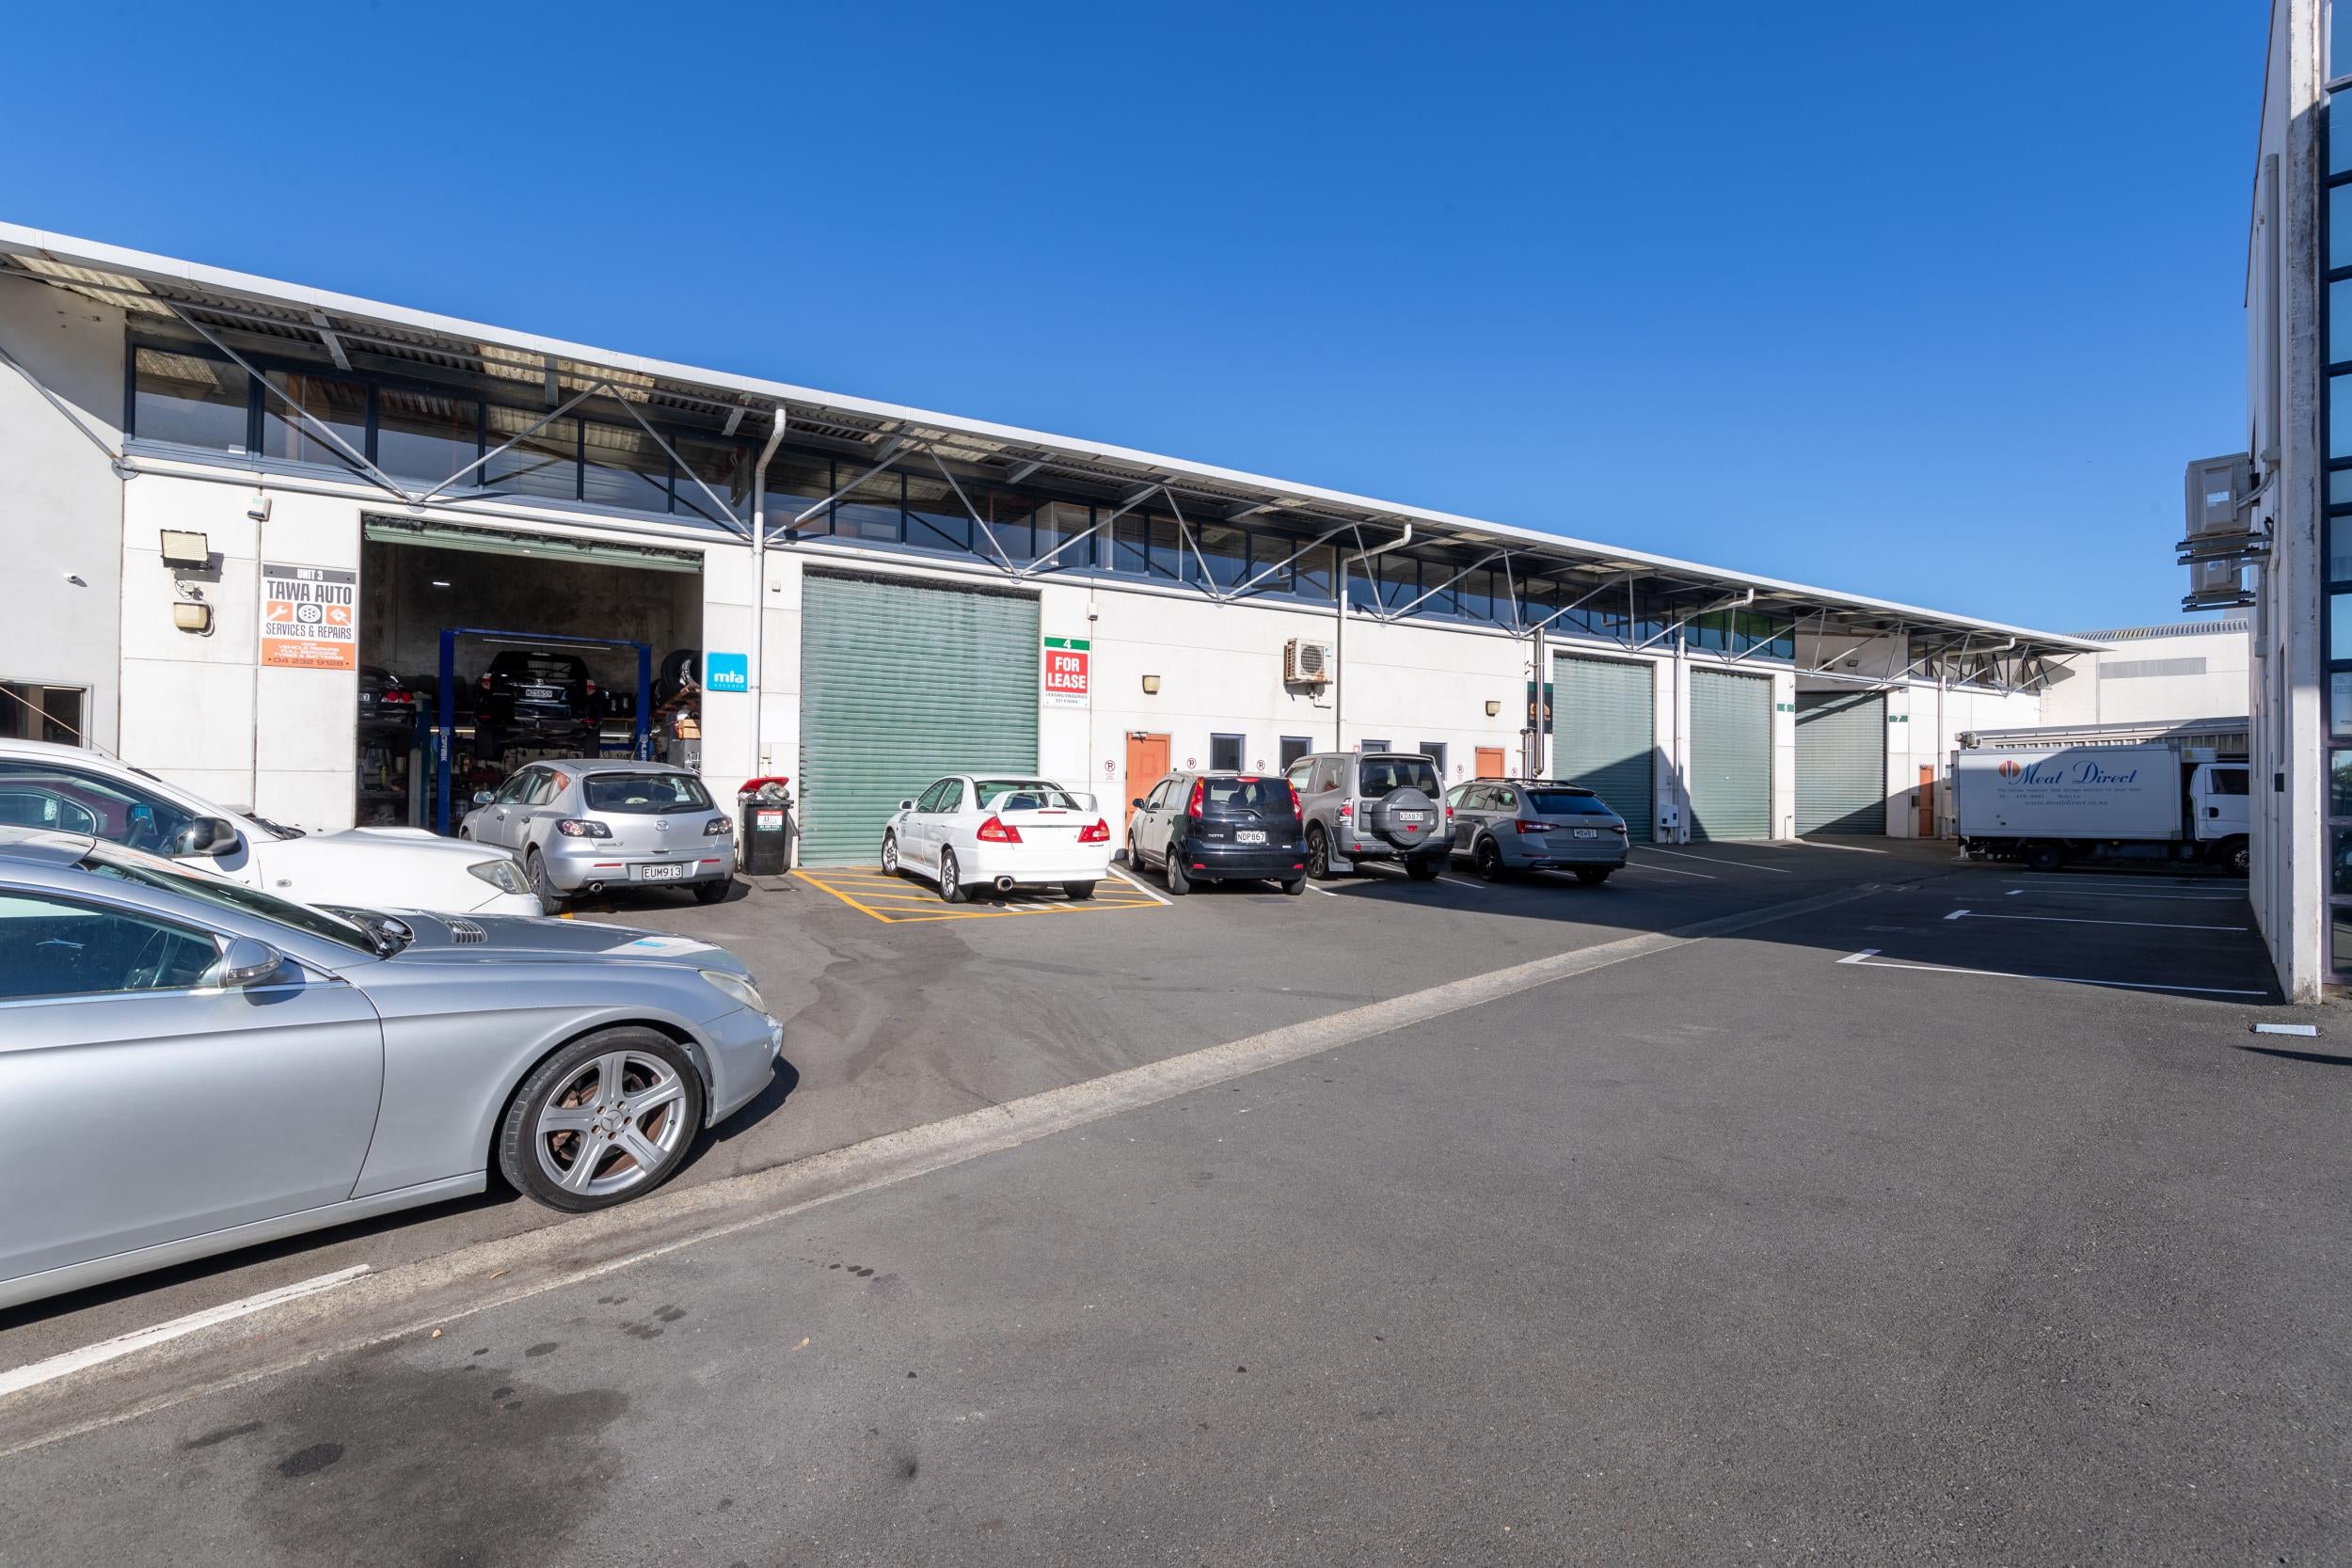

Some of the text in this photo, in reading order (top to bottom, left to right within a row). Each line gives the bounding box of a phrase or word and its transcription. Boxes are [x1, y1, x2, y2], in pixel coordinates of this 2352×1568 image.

[296, 568, 324, 581] UNIT 3
[267, 580, 352, 605] TAWA AUTO
[265, 623, 352, 640] SERVICES & REPAIRS
[1063, 639, 1072, 649] 4
[1055, 656, 1080, 673] FOR
[713, 670, 745, 684] mta
[1047, 672, 1087, 689] LEASE
[2008, 760, 2138, 784] Meat Direct
[1237, 832, 1265, 841] NDP867
[644, 867, 682, 878] EUM913
